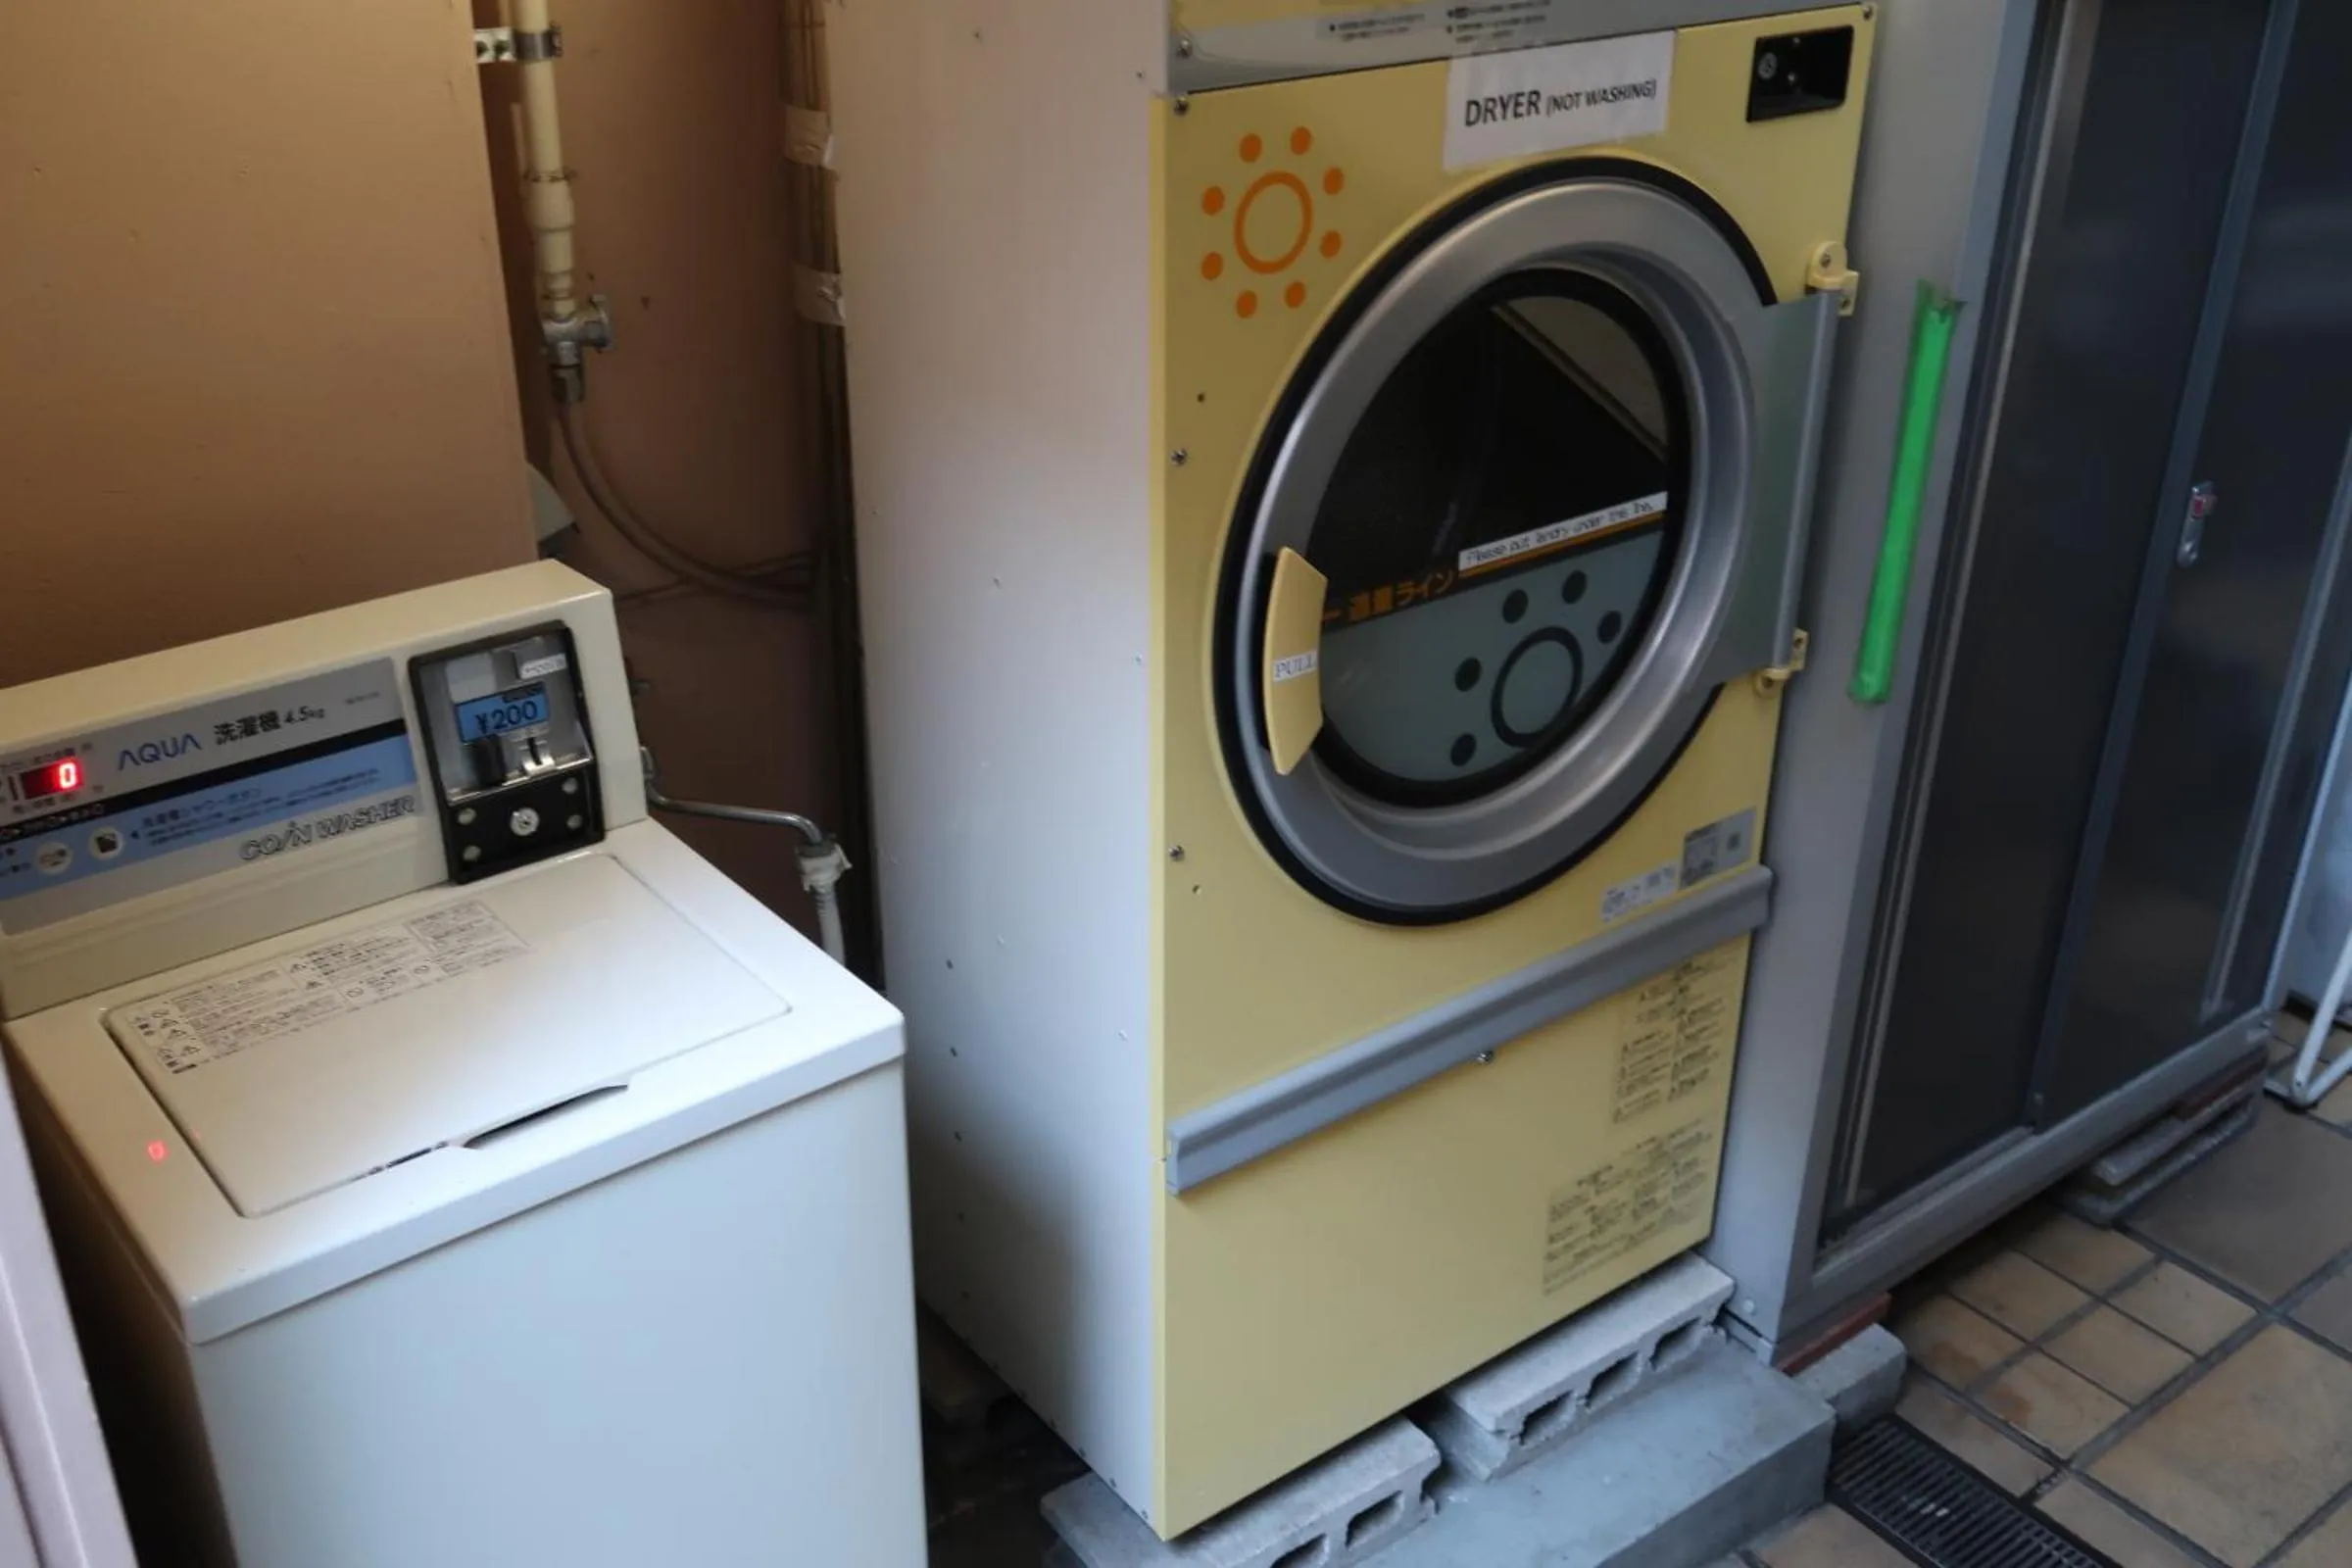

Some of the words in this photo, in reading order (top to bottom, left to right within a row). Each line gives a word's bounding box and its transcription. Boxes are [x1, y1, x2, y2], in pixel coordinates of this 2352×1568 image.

[1465, 89, 1542, 127] DRYER
[1545, 92, 1583, 118] (NOT
[1584, 77, 1657, 108] WASHING)
[475, 700, 538, 735] ¥200
[118, 733, 203, 771] AQUA
[59, 761, 76, 789] 0
[239, 819, 313, 860] COIN
[315, 794, 416, 839] WASHER
